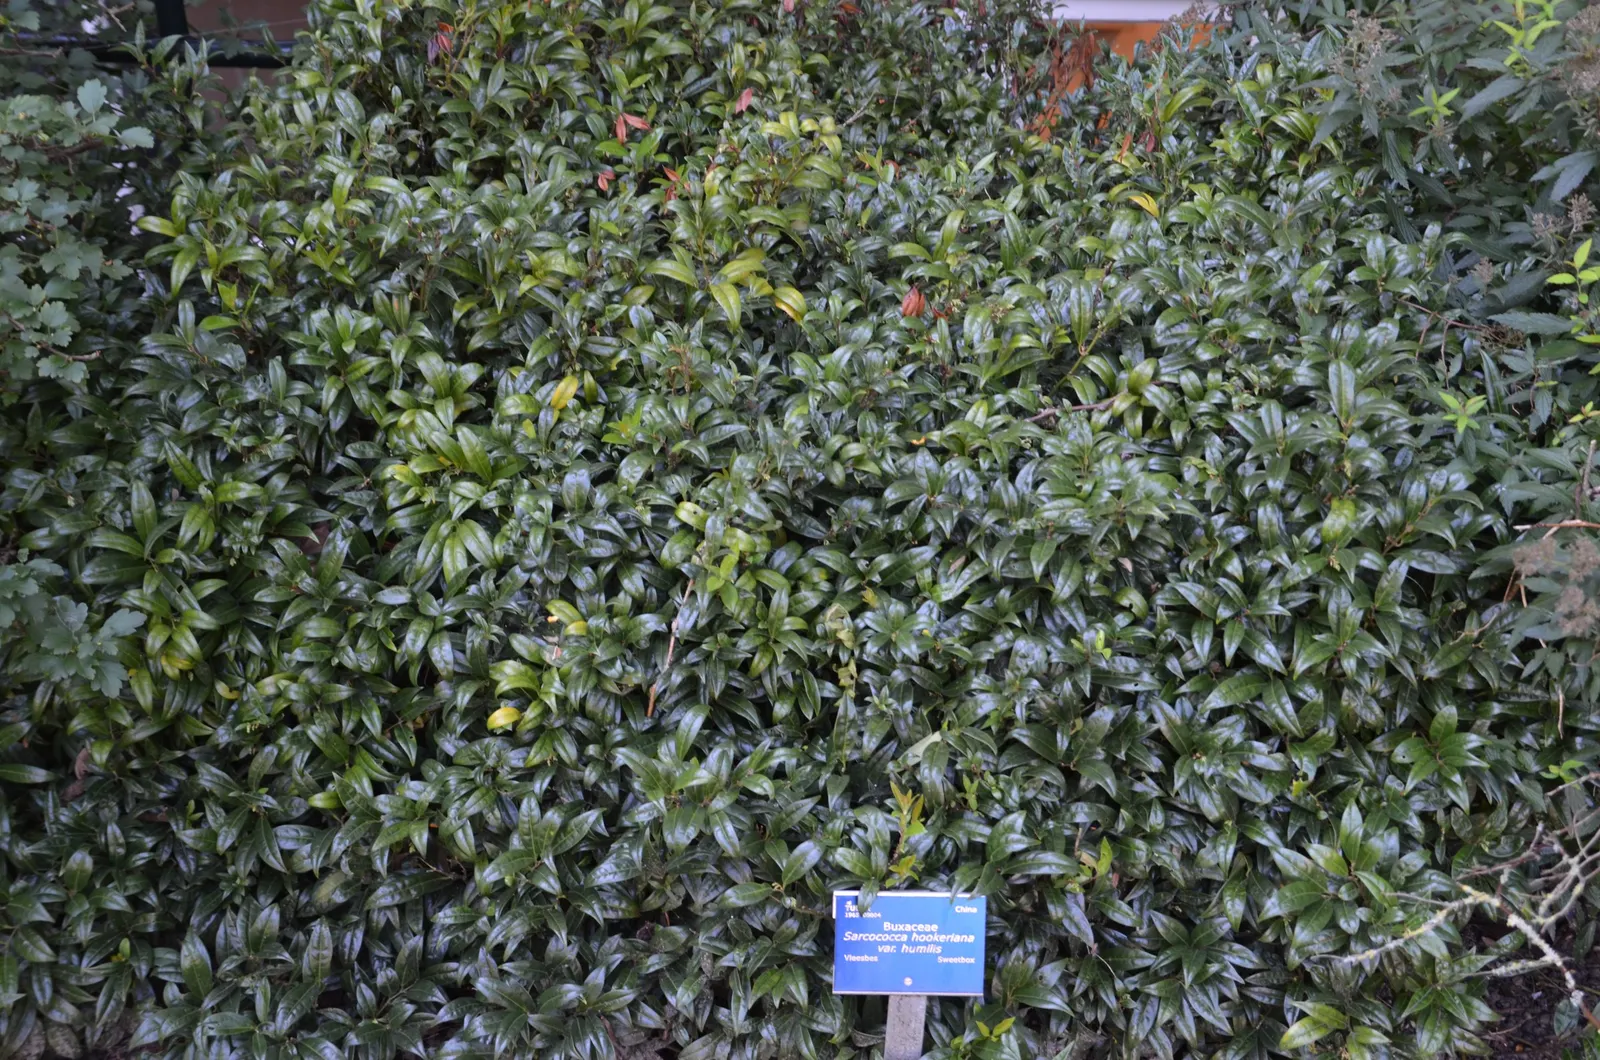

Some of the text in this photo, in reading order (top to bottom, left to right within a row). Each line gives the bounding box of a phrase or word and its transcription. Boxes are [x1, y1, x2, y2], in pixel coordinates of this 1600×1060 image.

[955, 905, 977, 913] China
[883, 922, 938, 932] Buxaceae
[843, 931, 975, 943] Sarcococca hookeriana
[878, 943, 942, 954] var. humilis
[844, 954, 878, 962] Vleesbes
[937, 956, 975, 964] Sweetbox
